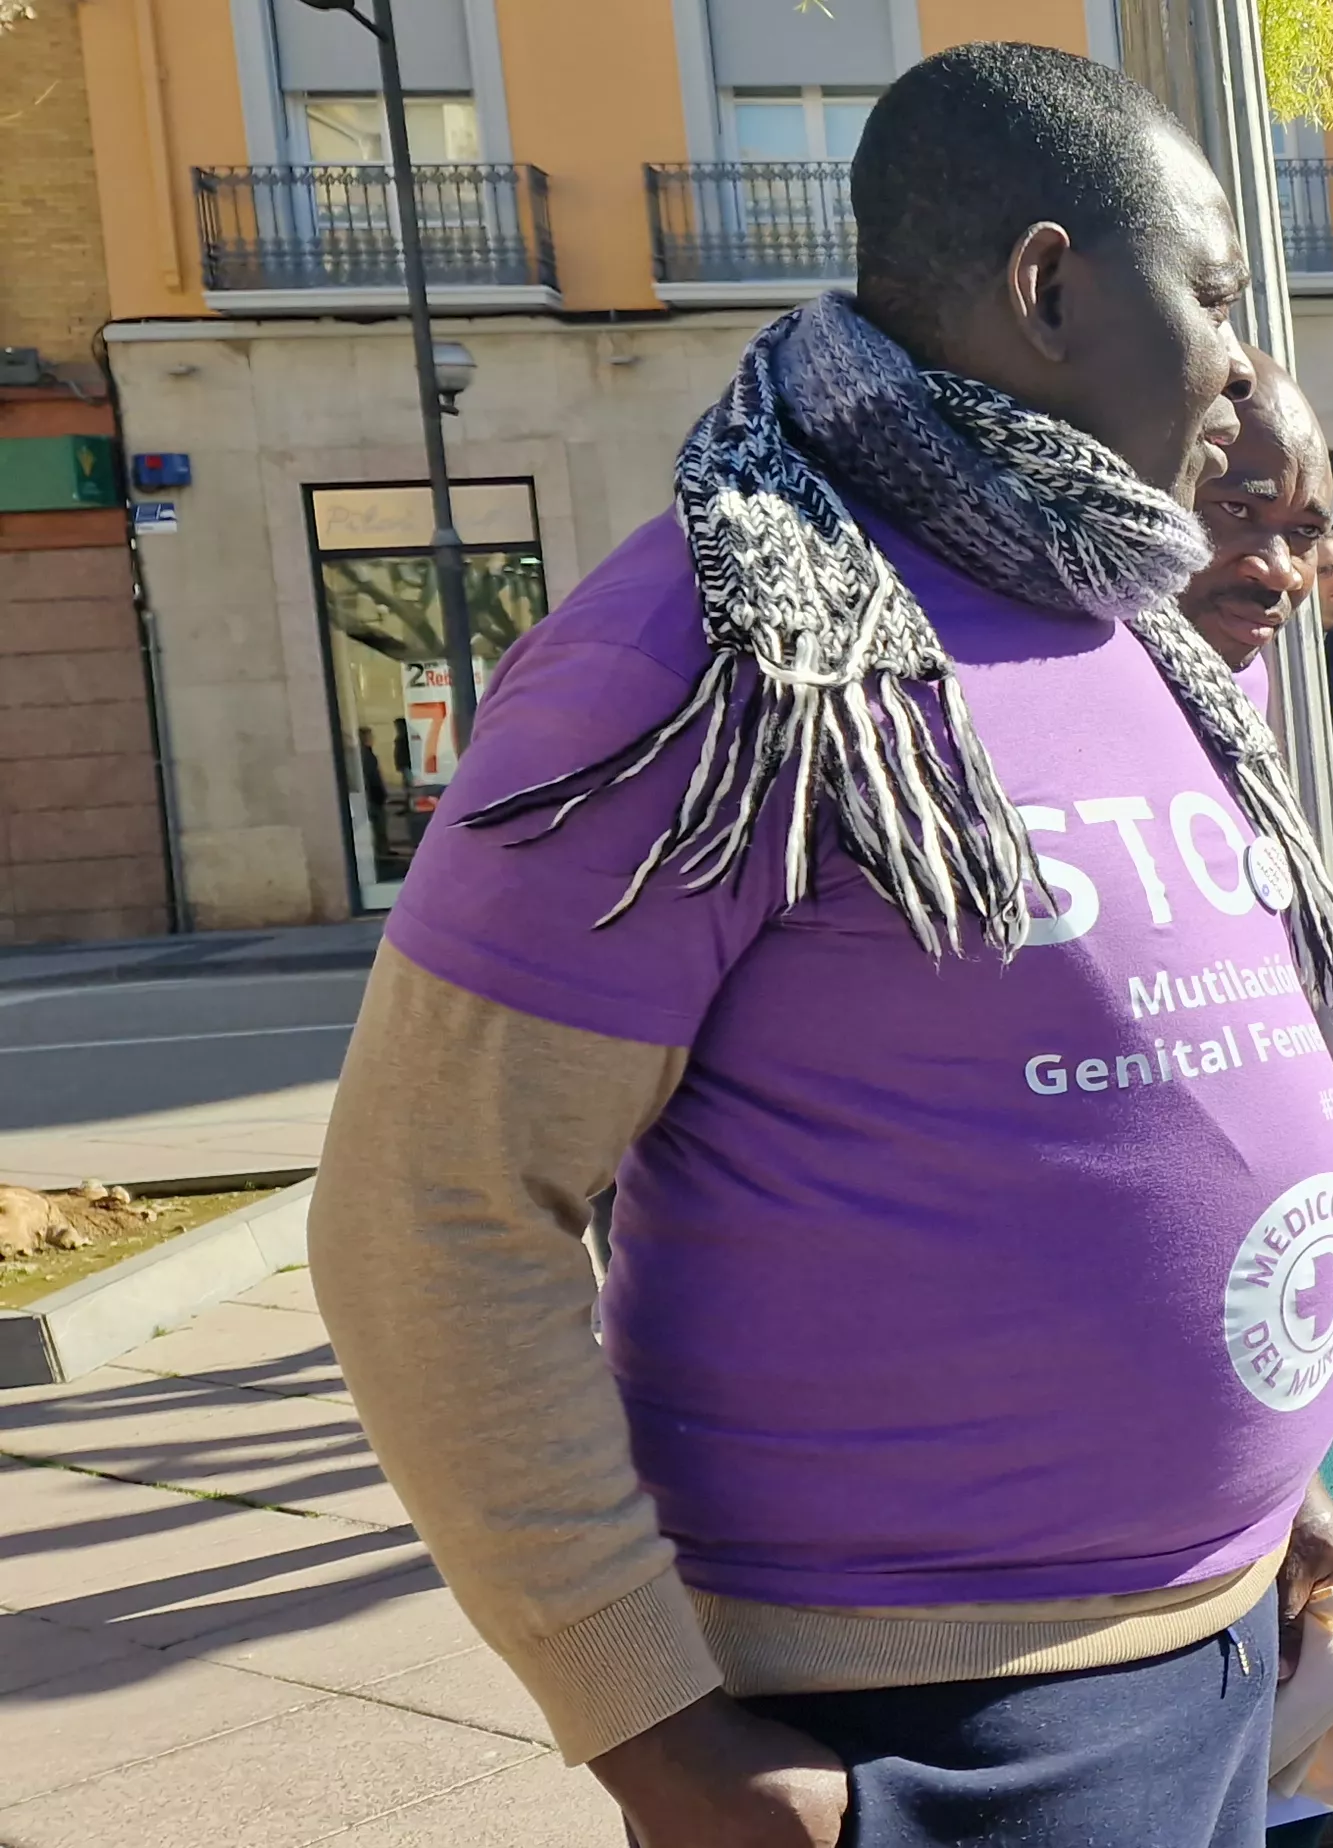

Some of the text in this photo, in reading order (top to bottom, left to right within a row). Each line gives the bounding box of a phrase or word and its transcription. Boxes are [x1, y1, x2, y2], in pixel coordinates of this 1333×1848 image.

[1010, 791, 1256, 946] STO
[1127, 954, 1301, 1019] Mutilación
[1025, 1026, 1243, 1096] Genital
[1242, 1320, 1284, 1389] DEL
